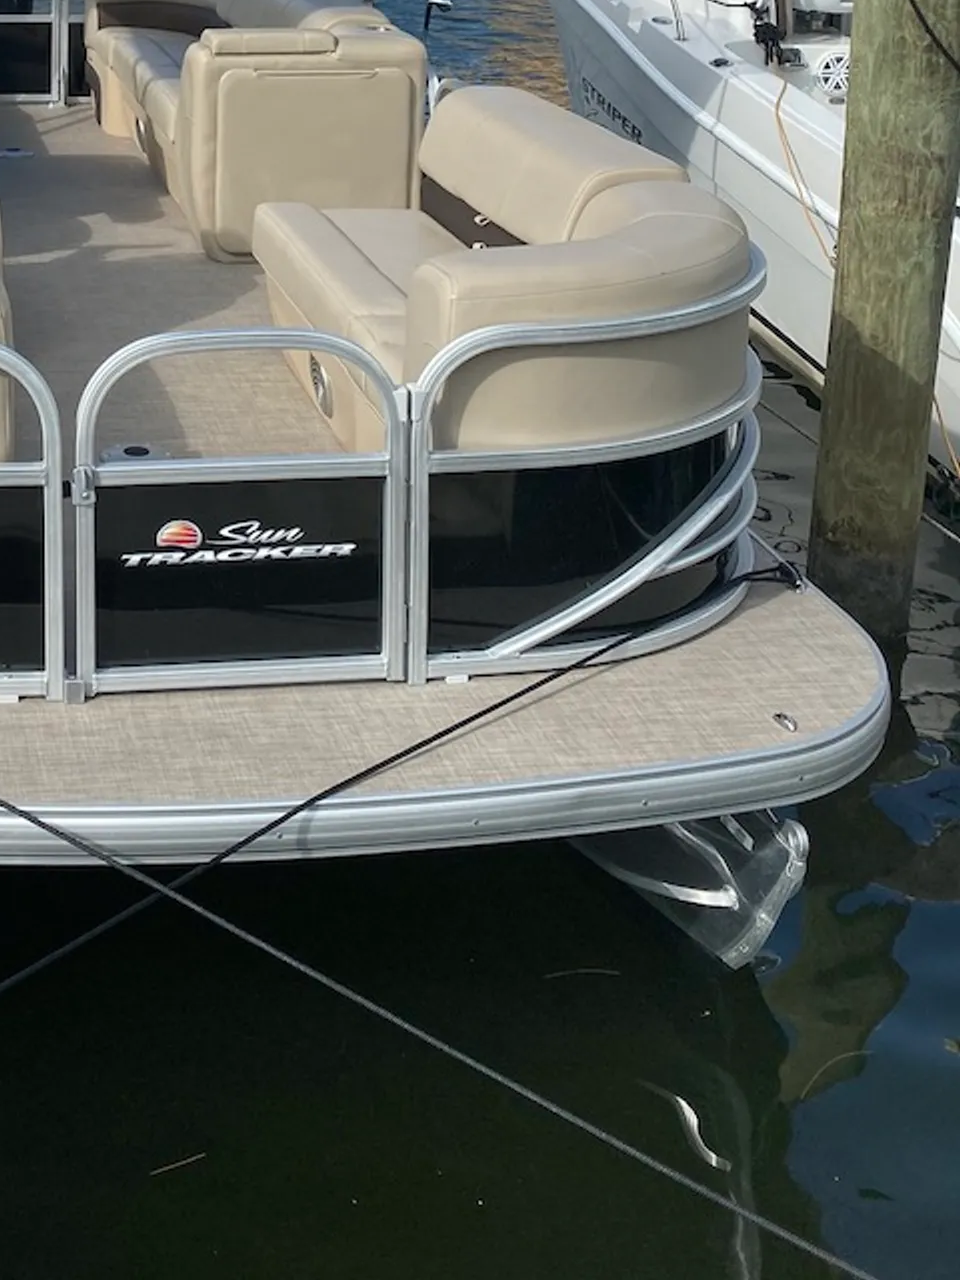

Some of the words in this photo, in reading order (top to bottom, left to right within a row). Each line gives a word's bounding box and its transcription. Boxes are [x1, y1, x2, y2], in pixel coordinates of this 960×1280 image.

[581, 76, 642, 145] STRIPER
[206, 520, 305, 545] Sun
[120, 543, 357, 567] TRACKER
